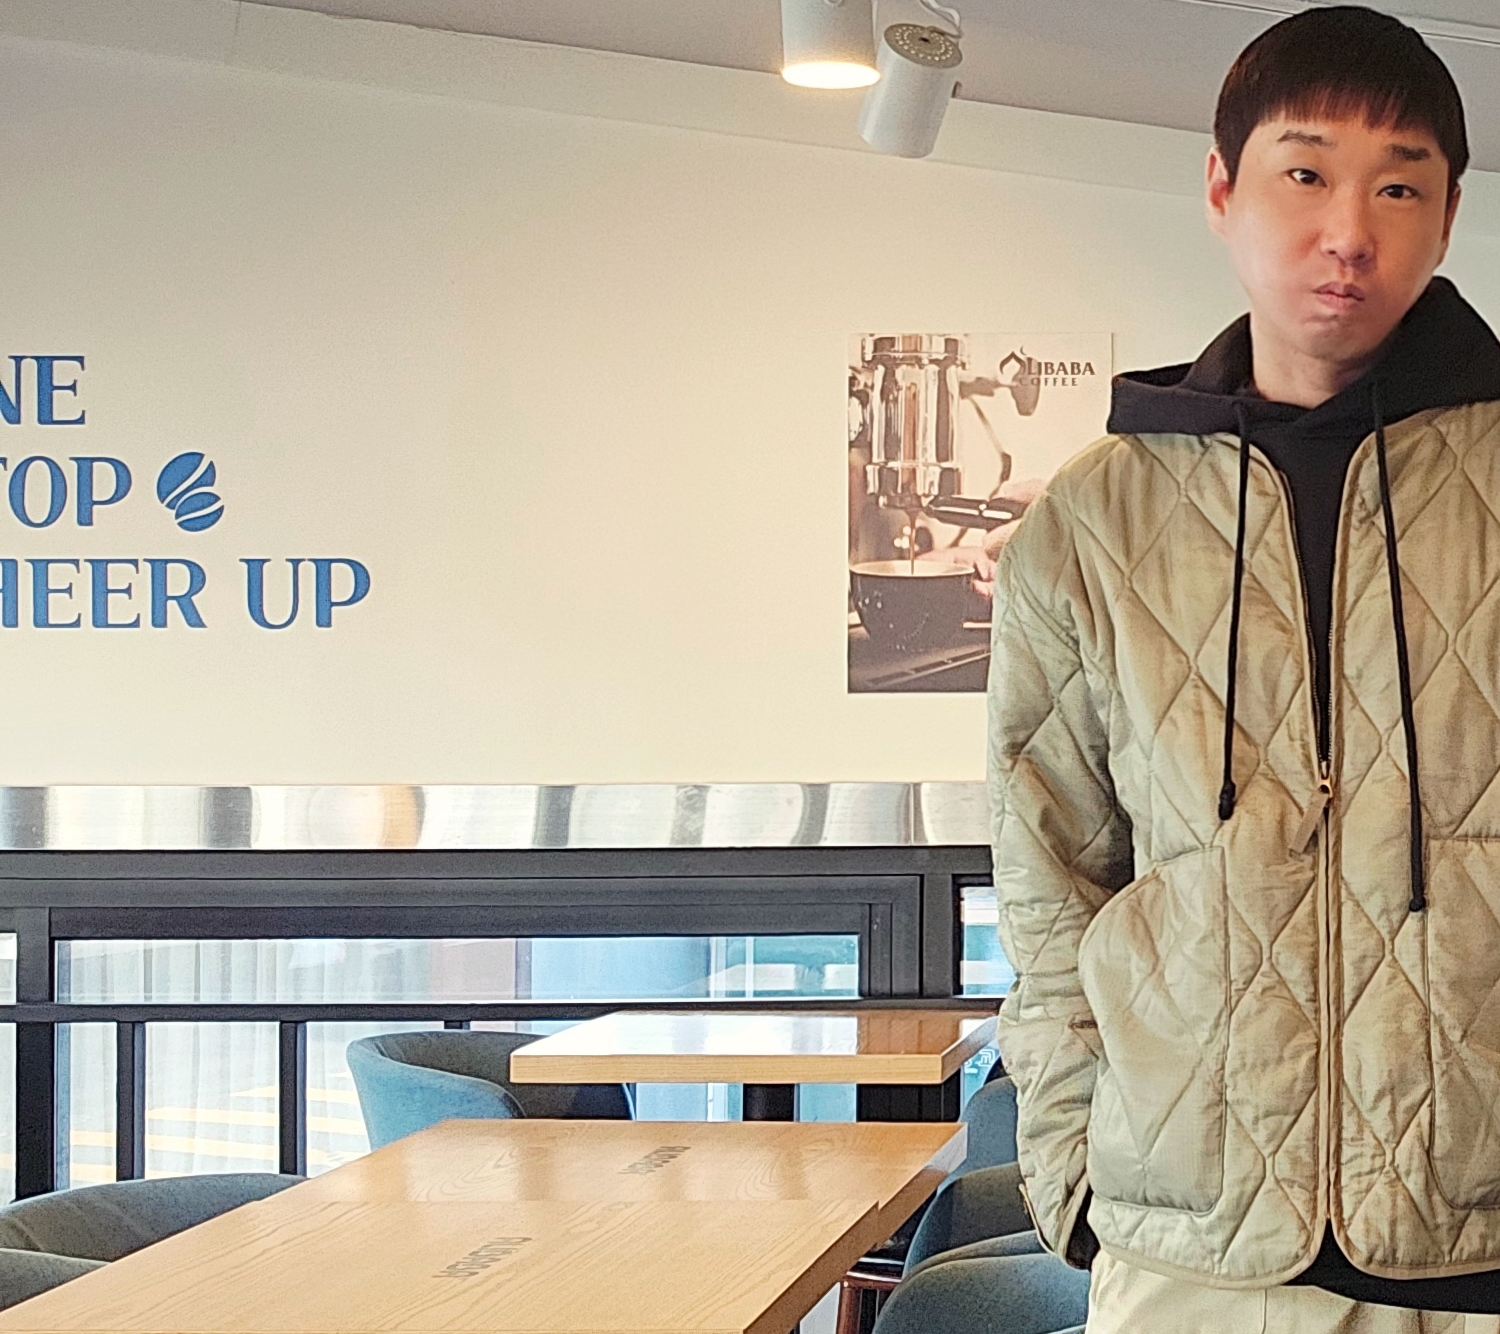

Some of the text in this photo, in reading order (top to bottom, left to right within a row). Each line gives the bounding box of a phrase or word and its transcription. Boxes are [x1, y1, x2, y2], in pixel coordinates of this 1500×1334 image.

[1018, 377, 1079, 387] COFFEE
[0, 455, 132, 528] OP
[239, 558, 371, 630] UP
